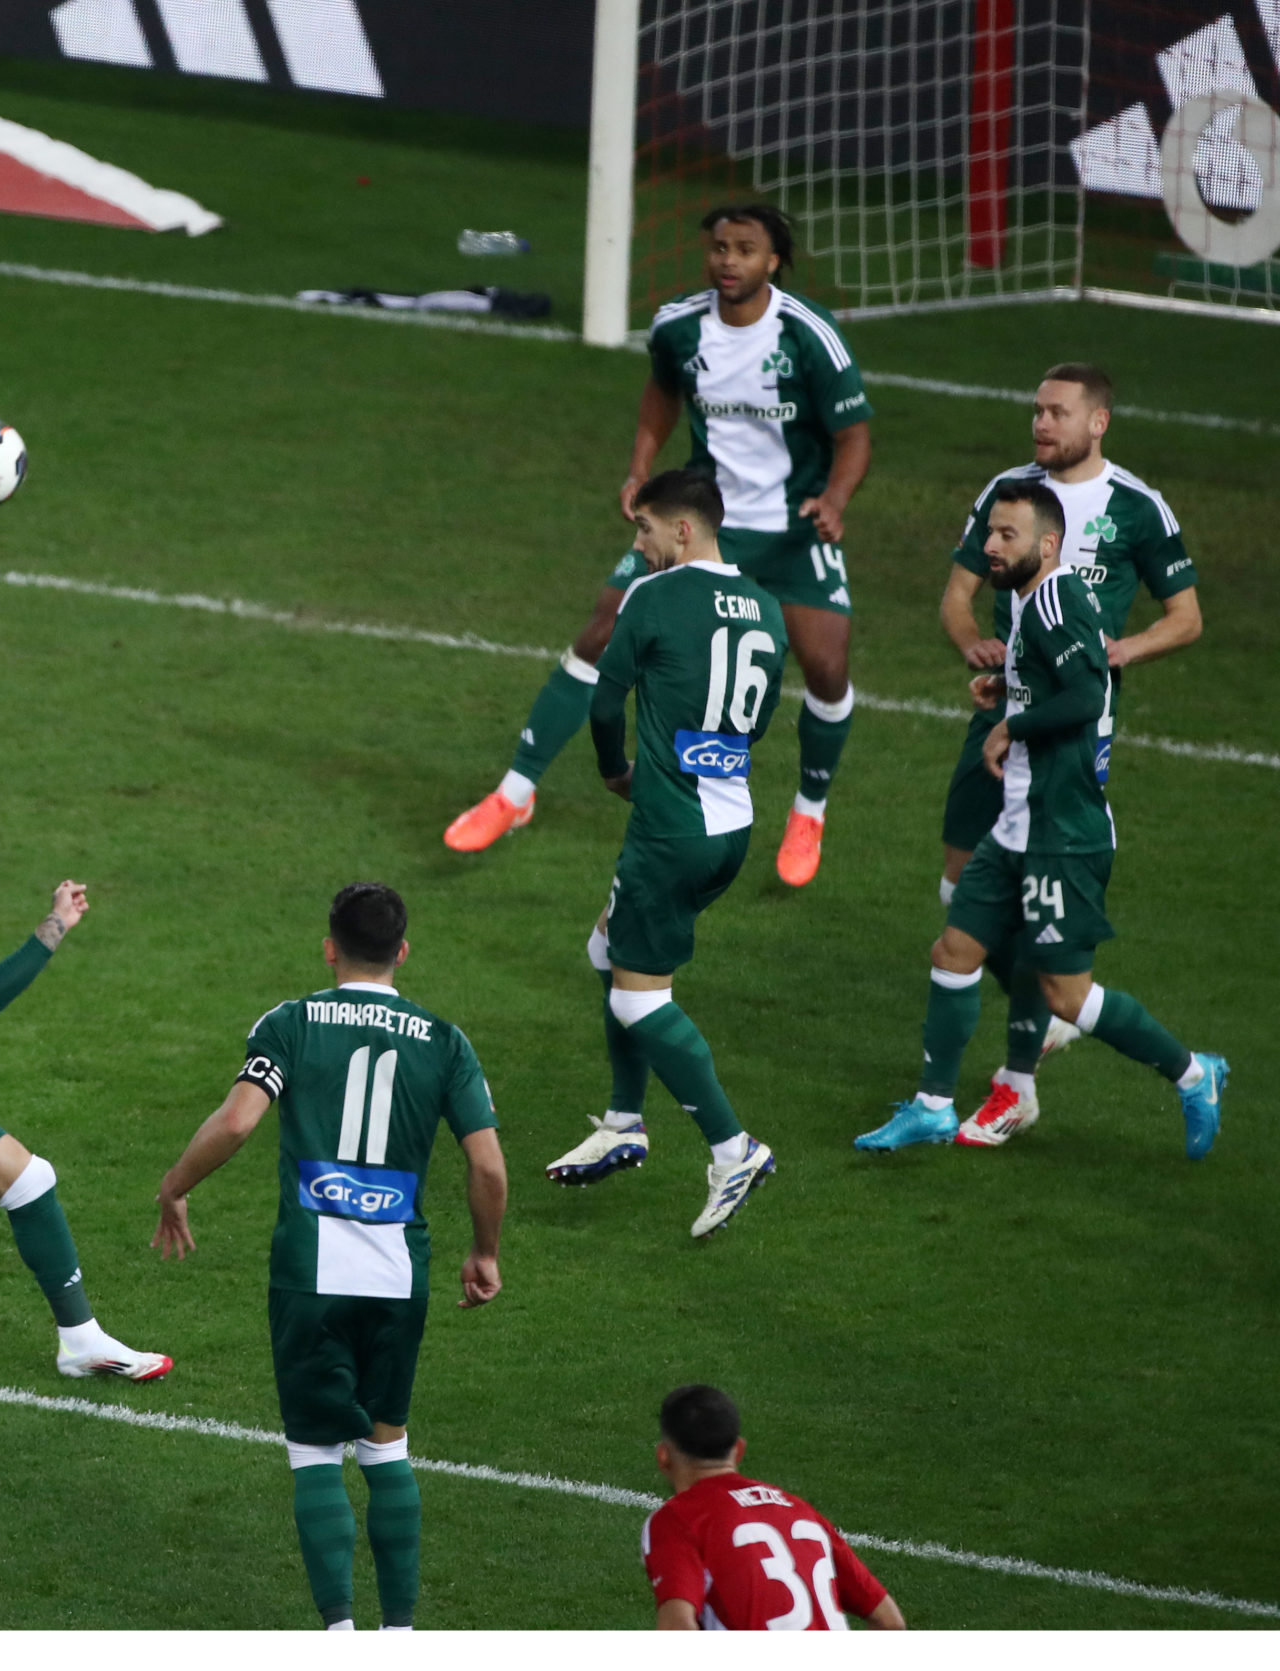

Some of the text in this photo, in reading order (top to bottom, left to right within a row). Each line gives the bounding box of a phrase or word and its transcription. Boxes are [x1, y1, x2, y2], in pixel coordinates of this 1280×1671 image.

[810, 543, 847, 583] 14
[702, 627, 776, 734] 16
[1022, 875, 1065, 921] 24
[306, 1001, 432, 1041] ΜΠΑΚΑΣΕΤΑΣ
[337, 1046, 398, 1164] 11
[732, 1520, 850, 1630] 32
